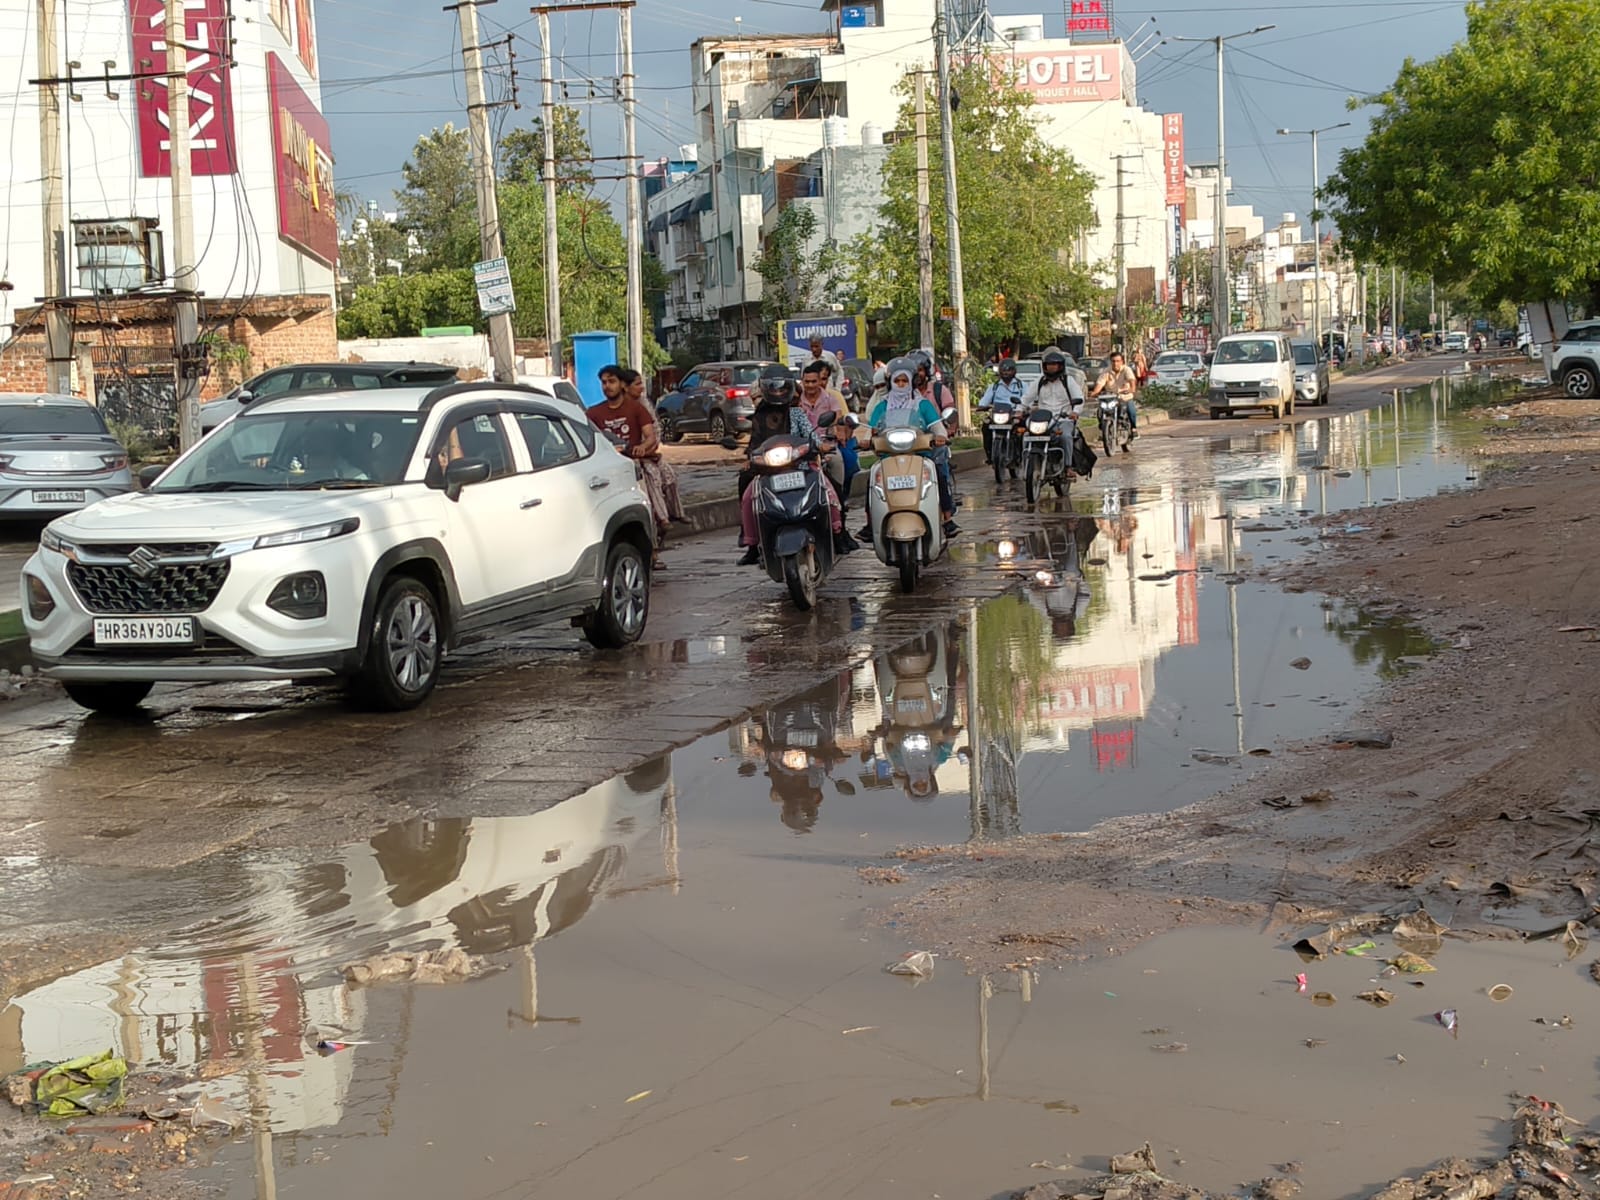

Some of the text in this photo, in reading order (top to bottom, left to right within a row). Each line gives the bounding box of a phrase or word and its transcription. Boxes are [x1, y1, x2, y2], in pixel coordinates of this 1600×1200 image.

[1073, 85, 1099, 97] HALL
[1168, 141, 1180, 185] HOTEL
[794, 323, 847, 340] LUMINOUS
